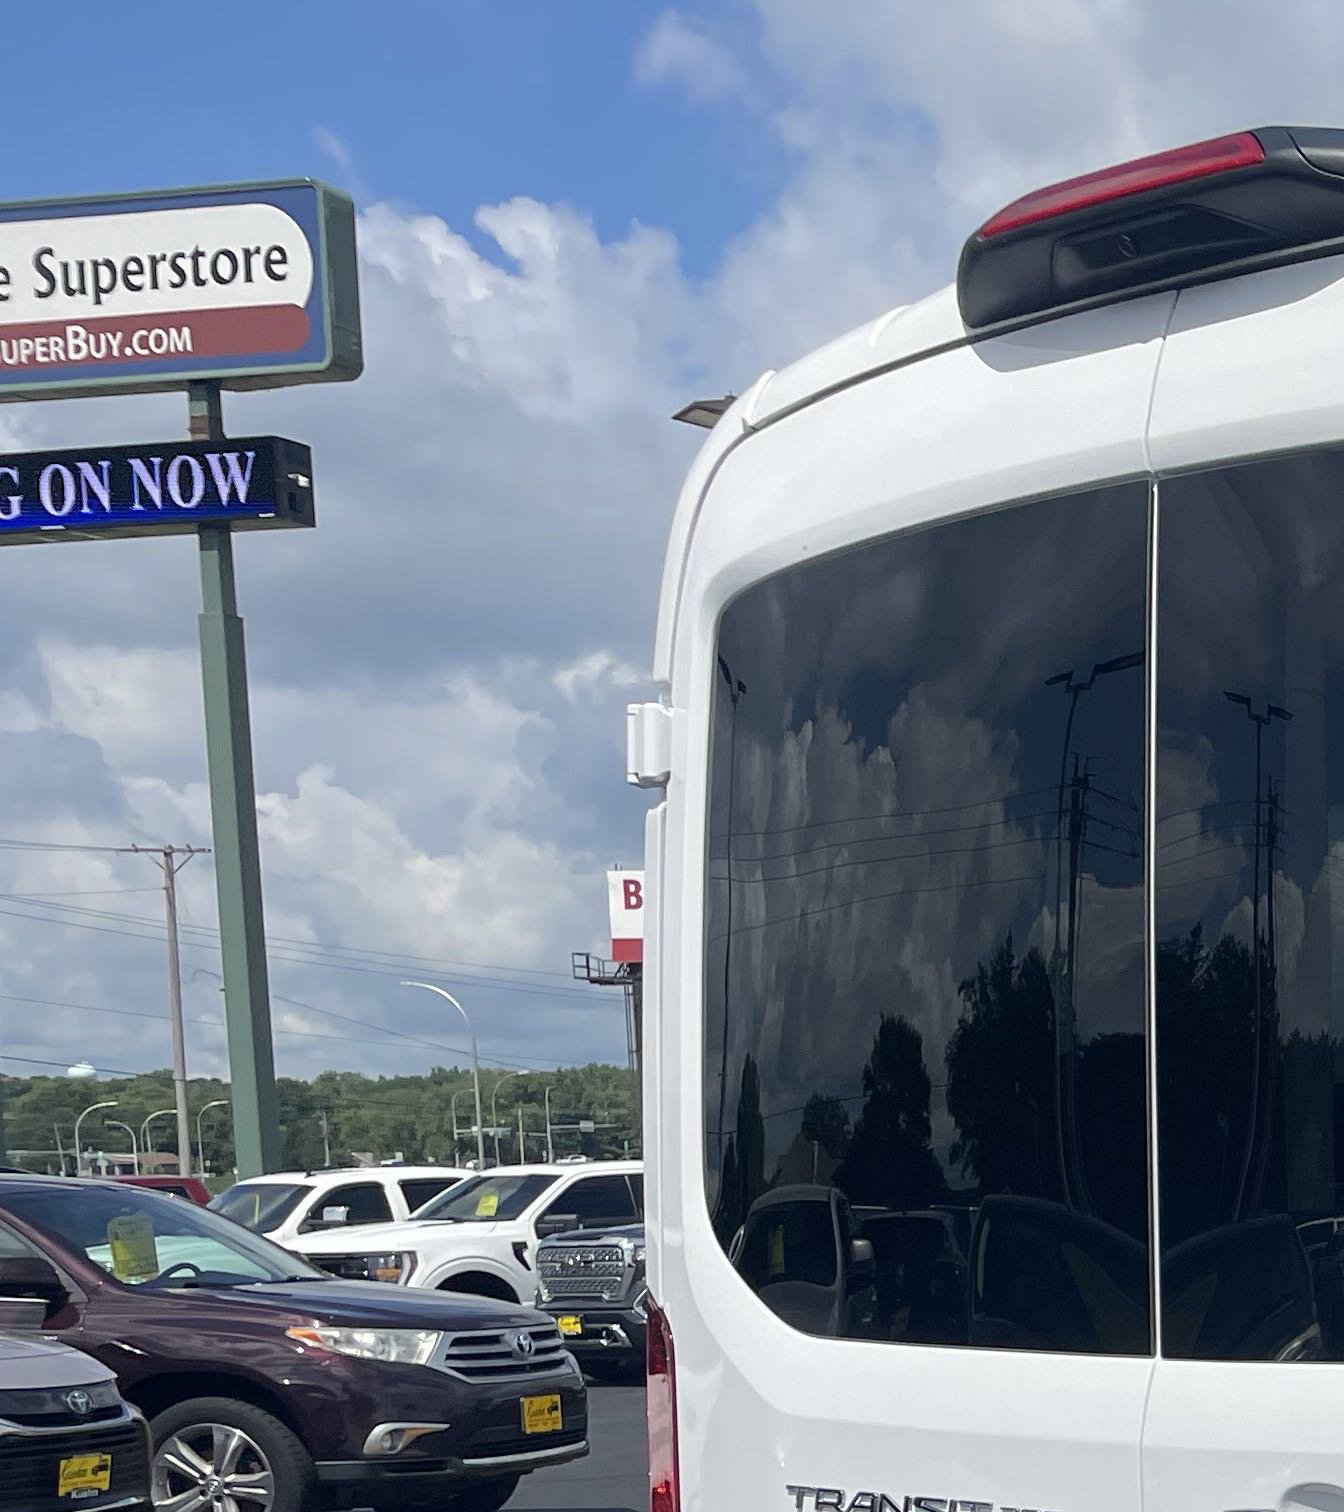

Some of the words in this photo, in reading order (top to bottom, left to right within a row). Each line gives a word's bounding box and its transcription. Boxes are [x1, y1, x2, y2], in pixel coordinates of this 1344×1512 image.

[33, 244, 288, 305] Superstore
[38, 460, 112, 517] ON
[127, 451, 256, 511] NOW
[623, 879, 643, 910] B
